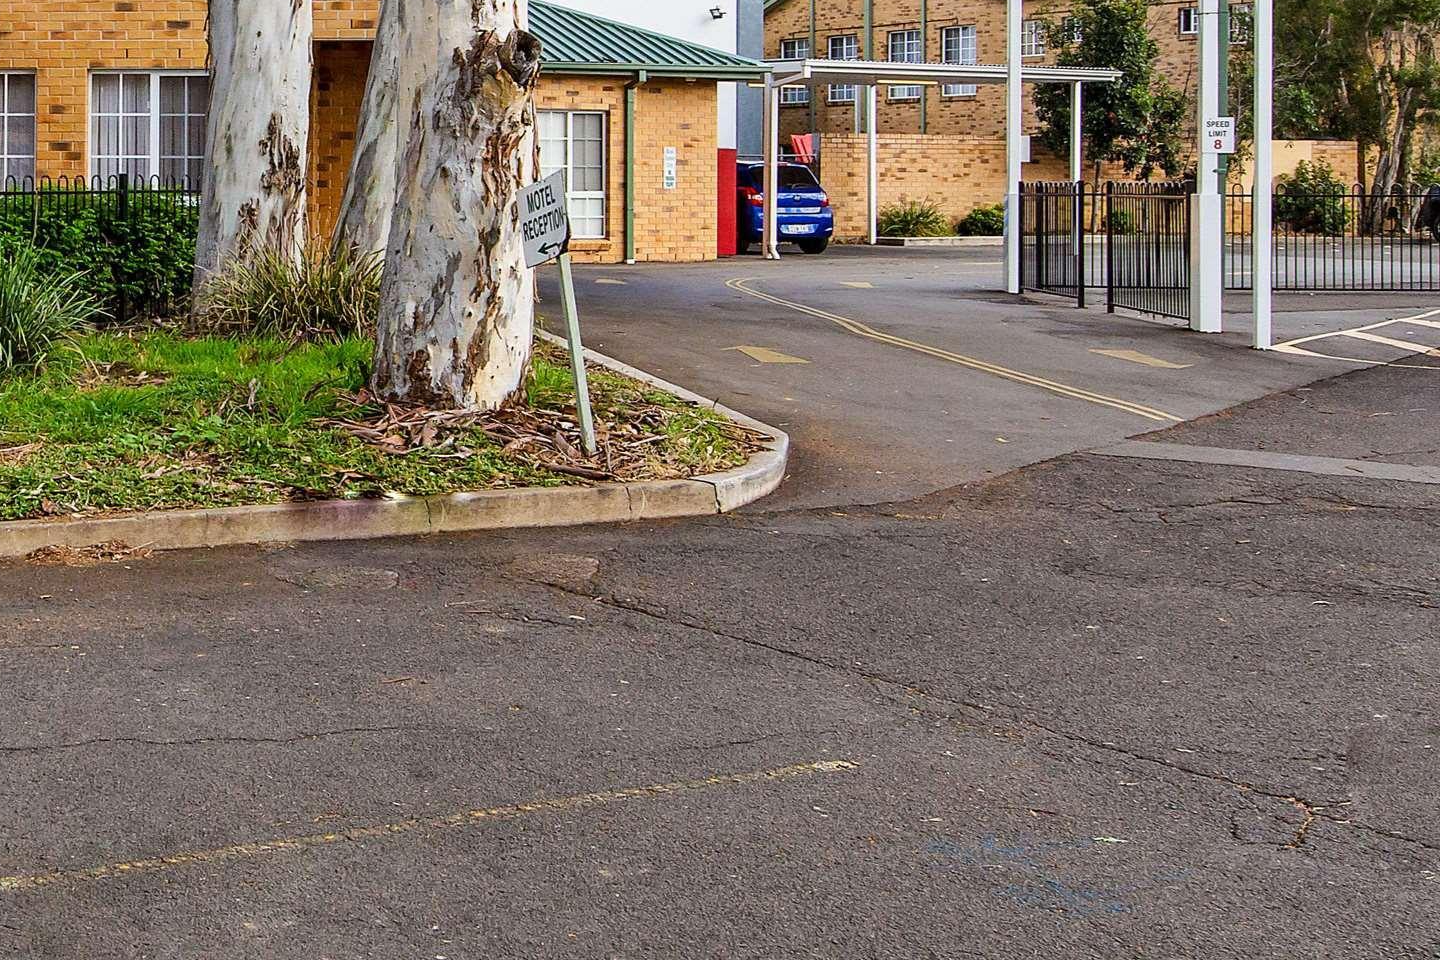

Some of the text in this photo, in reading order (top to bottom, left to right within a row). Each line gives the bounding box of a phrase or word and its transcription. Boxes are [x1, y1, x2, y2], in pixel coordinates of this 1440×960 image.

[1206, 120, 1230, 128] SPEED
[1214, 139, 1222, 150] 8
[526, 184, 556, 214] MOTEL
[522, 206, 565, 242] RECEPTION
